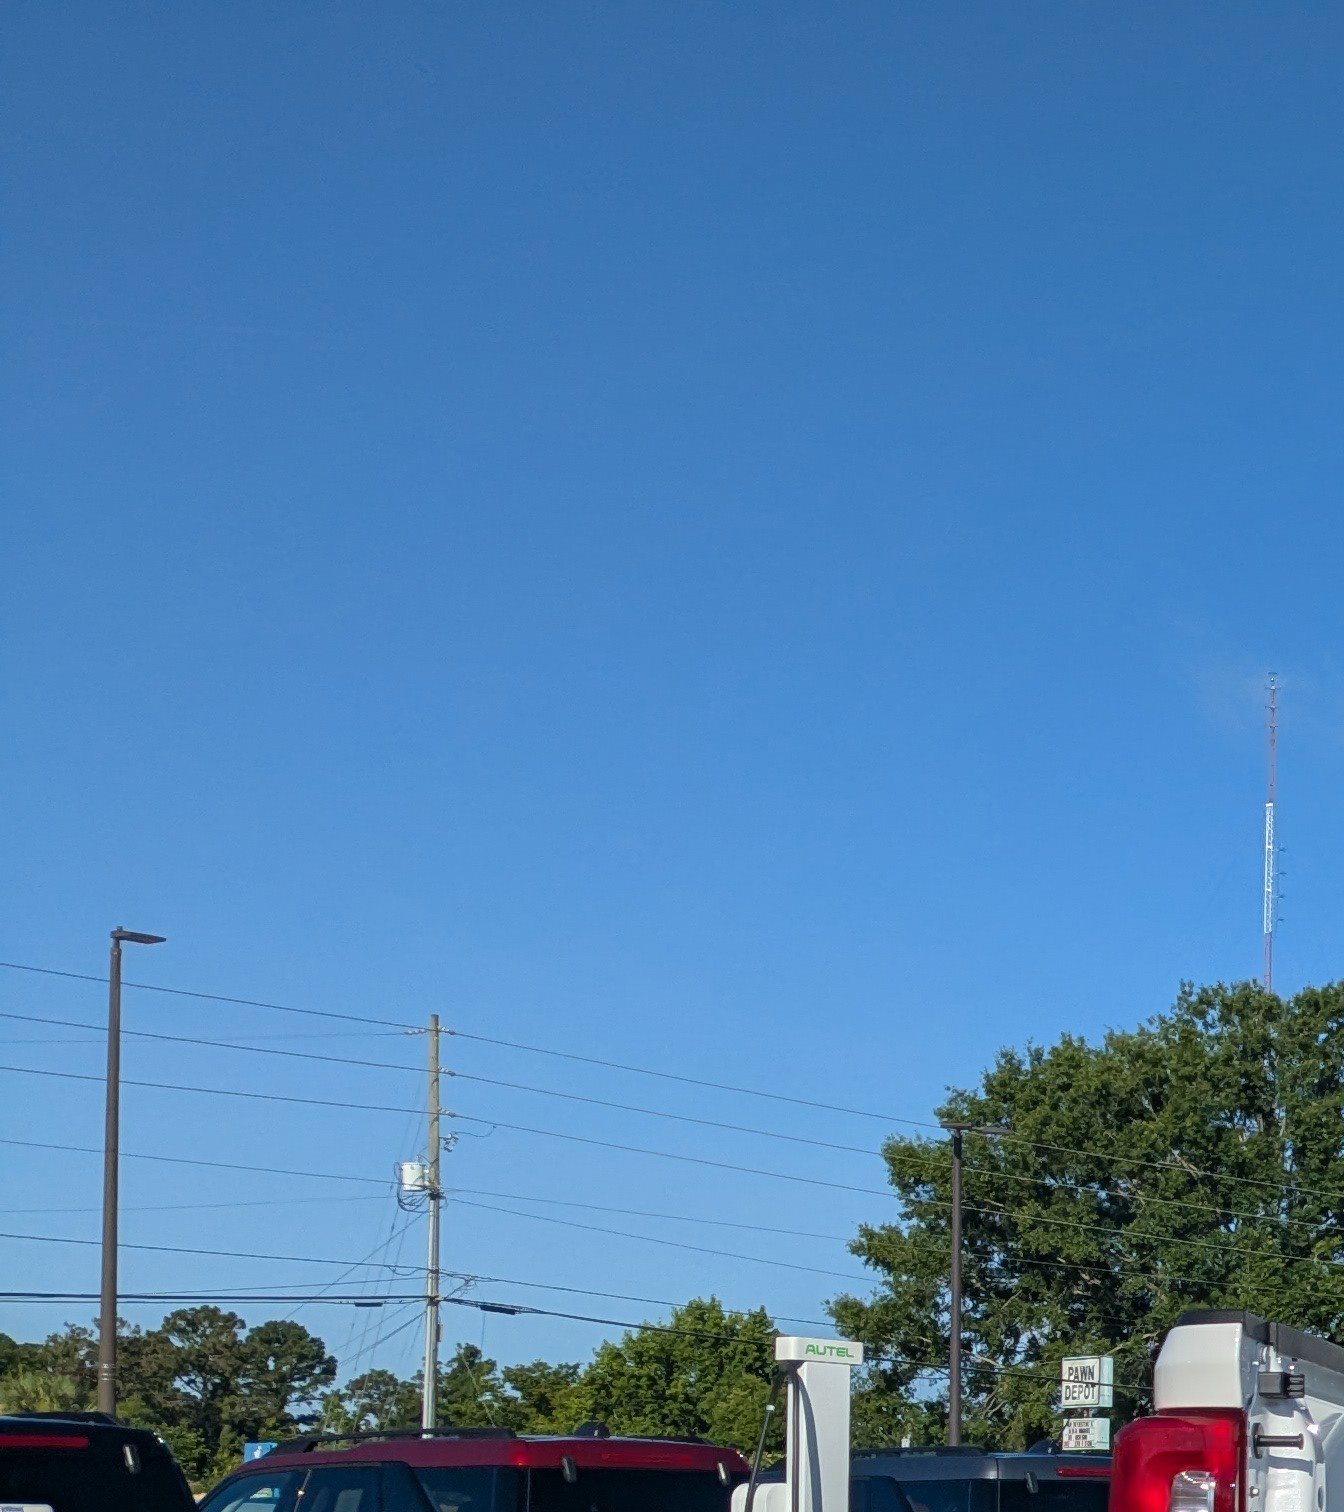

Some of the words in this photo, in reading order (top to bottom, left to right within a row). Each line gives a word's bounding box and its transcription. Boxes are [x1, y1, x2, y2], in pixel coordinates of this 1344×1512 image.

[805, 1344, 855, 1358] AUTEL
[1067, 1365, 1096, 1382] PAWN
[1064, 1384, 1097, 1401] DEPOT
